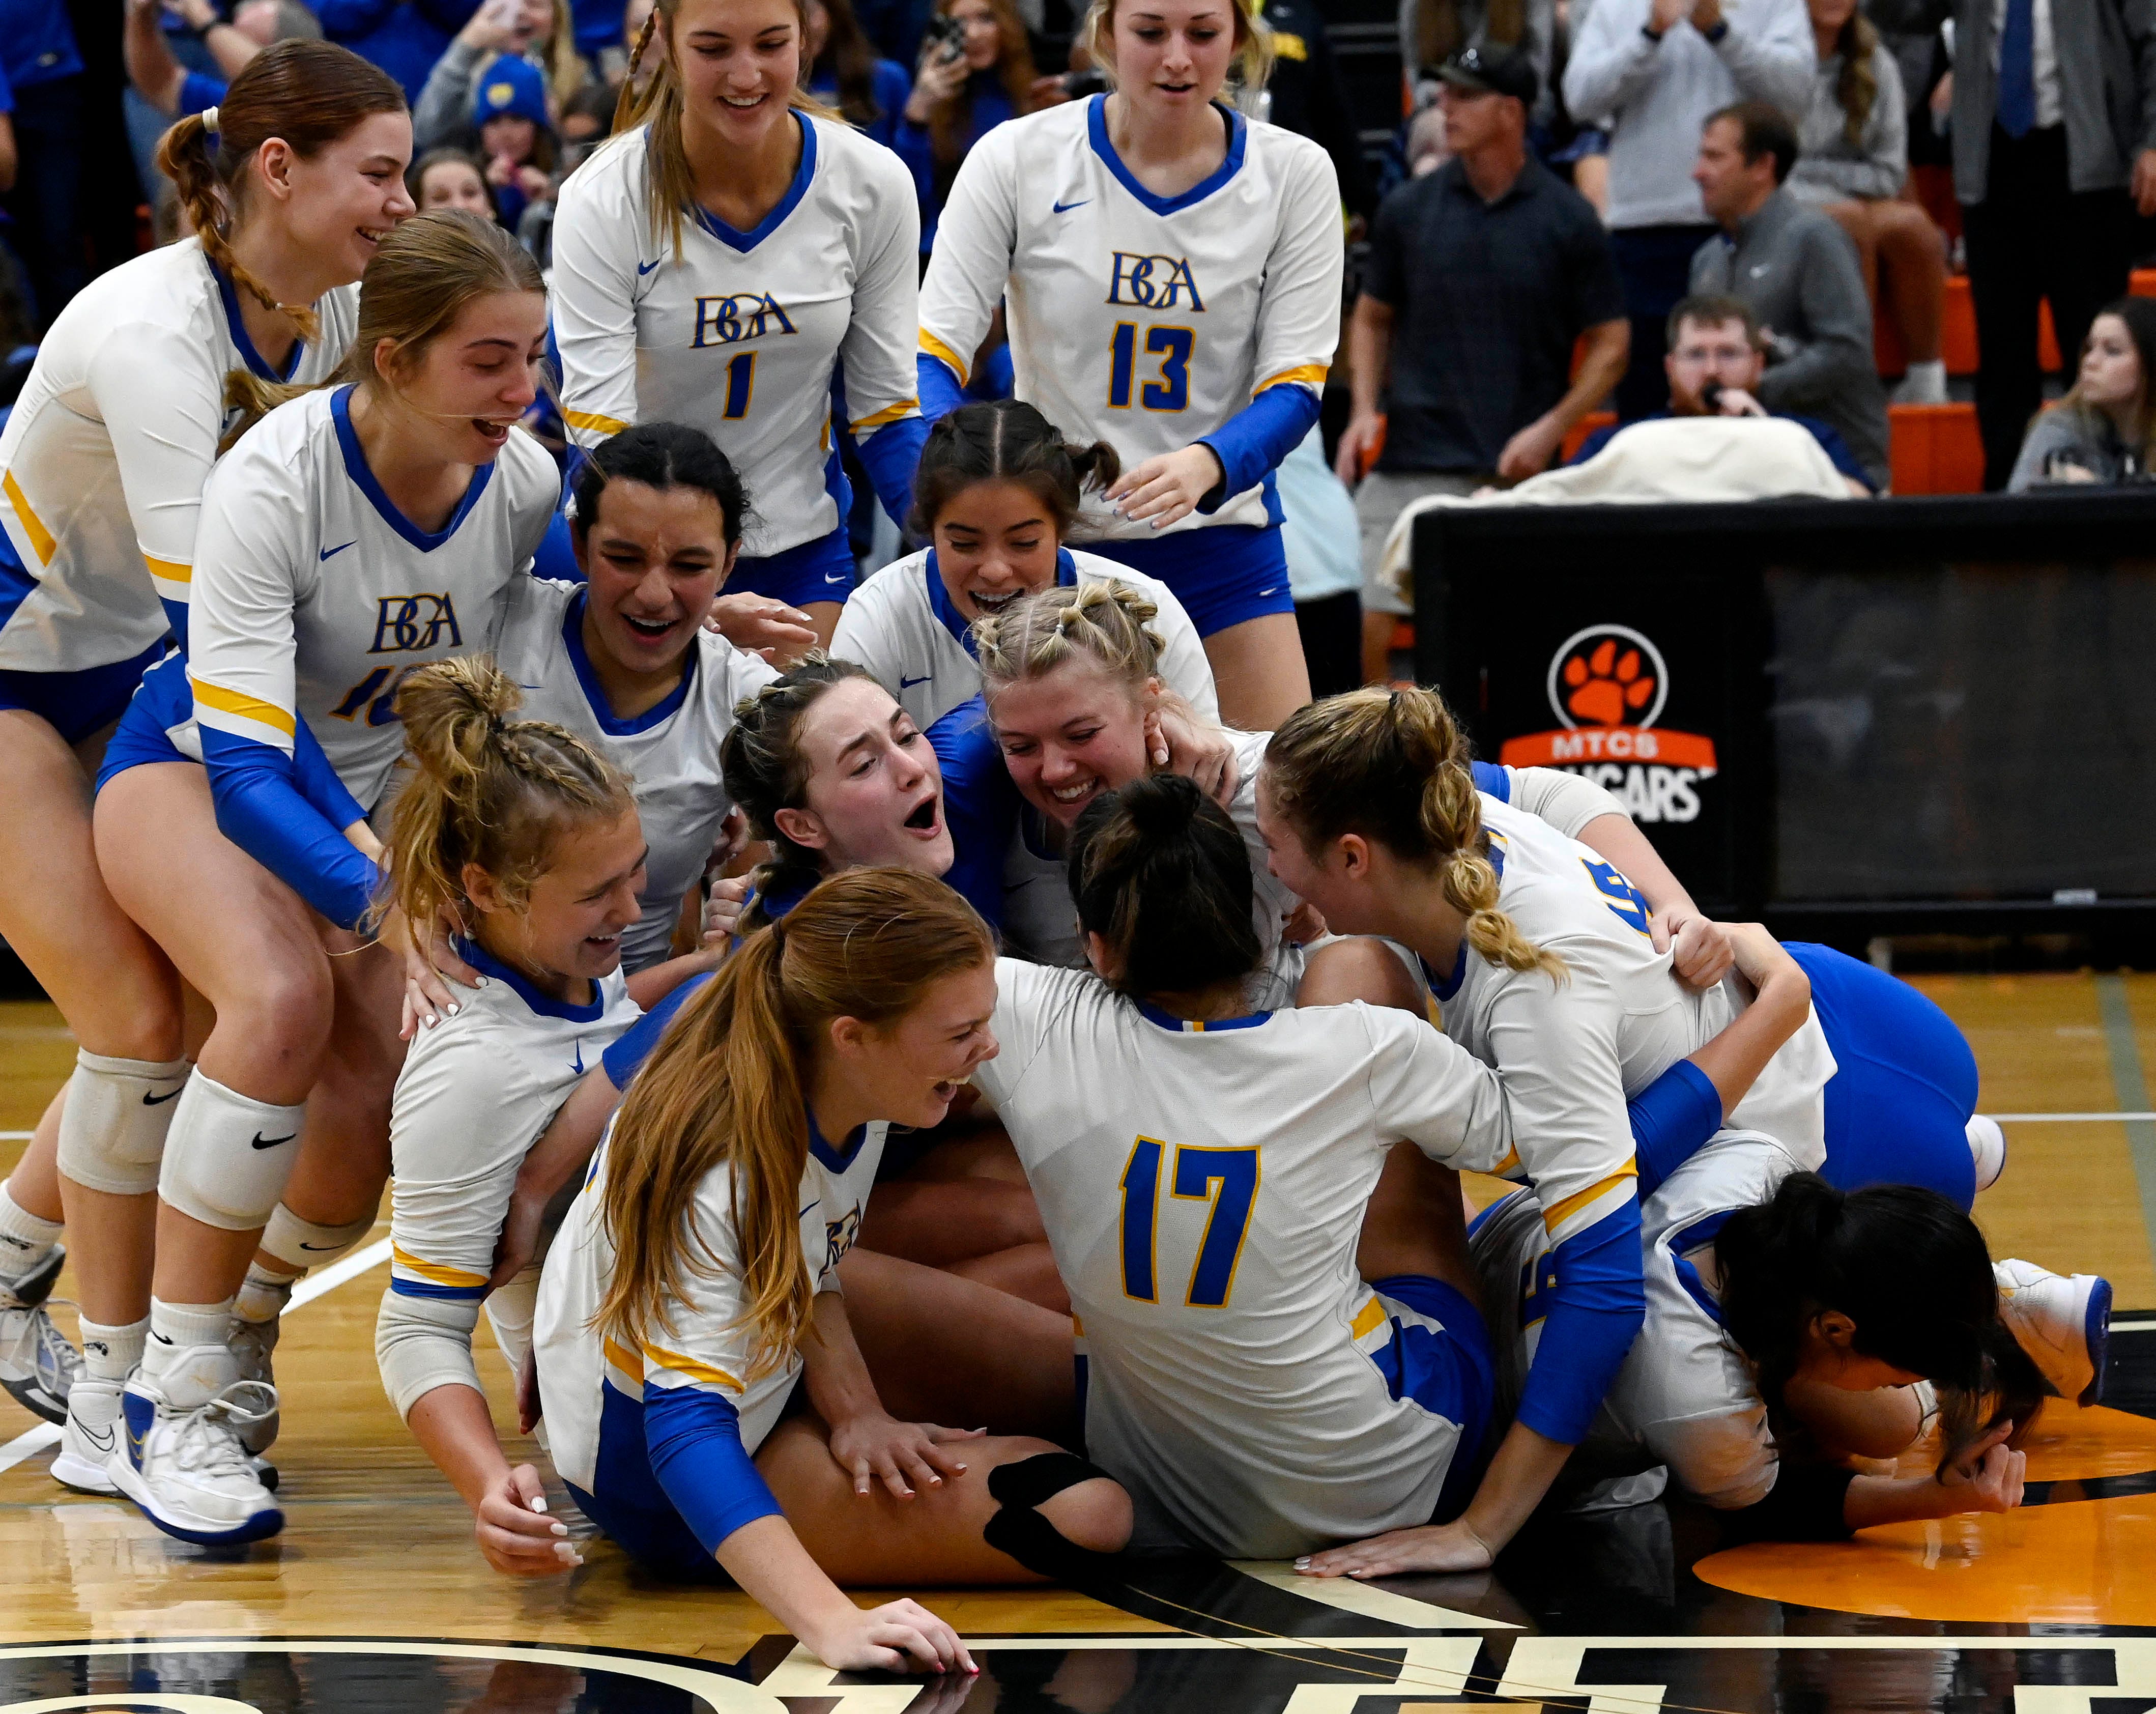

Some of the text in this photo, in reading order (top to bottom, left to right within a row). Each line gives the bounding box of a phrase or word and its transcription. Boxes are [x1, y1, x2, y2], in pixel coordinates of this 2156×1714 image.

[1105, 251, 1207, 312] BGA
[689, 290, 799, 349] BGA
[723, 350, 758, 421] 1
[1107, 320, 1196, 413] 13
[366, 591, 463, 655] BGA
[1118, 1134, 1261, 1309] 17
